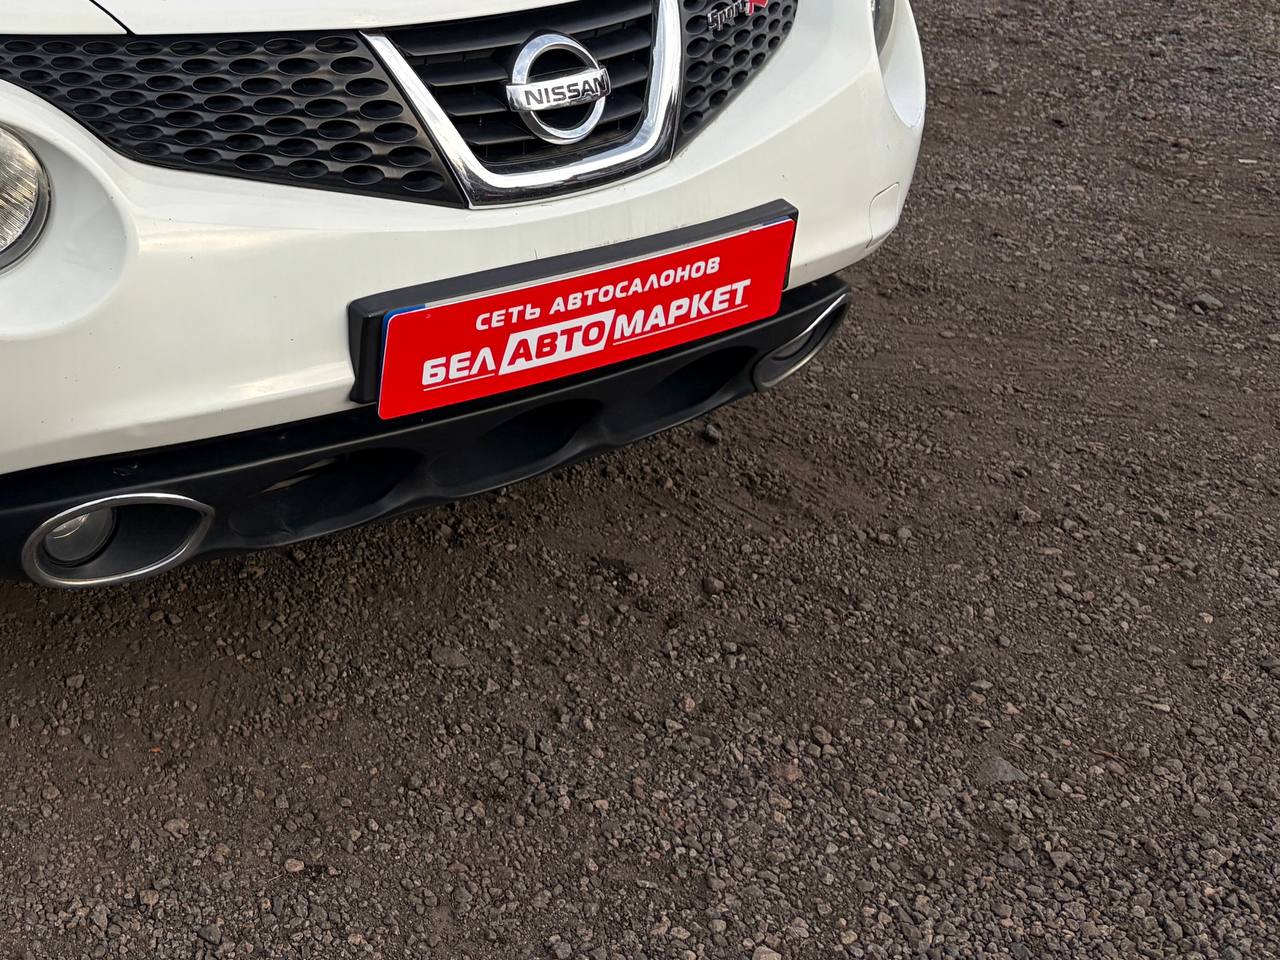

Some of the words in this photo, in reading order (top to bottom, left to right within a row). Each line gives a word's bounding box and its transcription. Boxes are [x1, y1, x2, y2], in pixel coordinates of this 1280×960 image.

[524, 76, 606, 106] NISSAN
[475, 304, 541, 331] СЕТЬ
[549, 256, 721, 315] АВТОСАЛОНОВ
